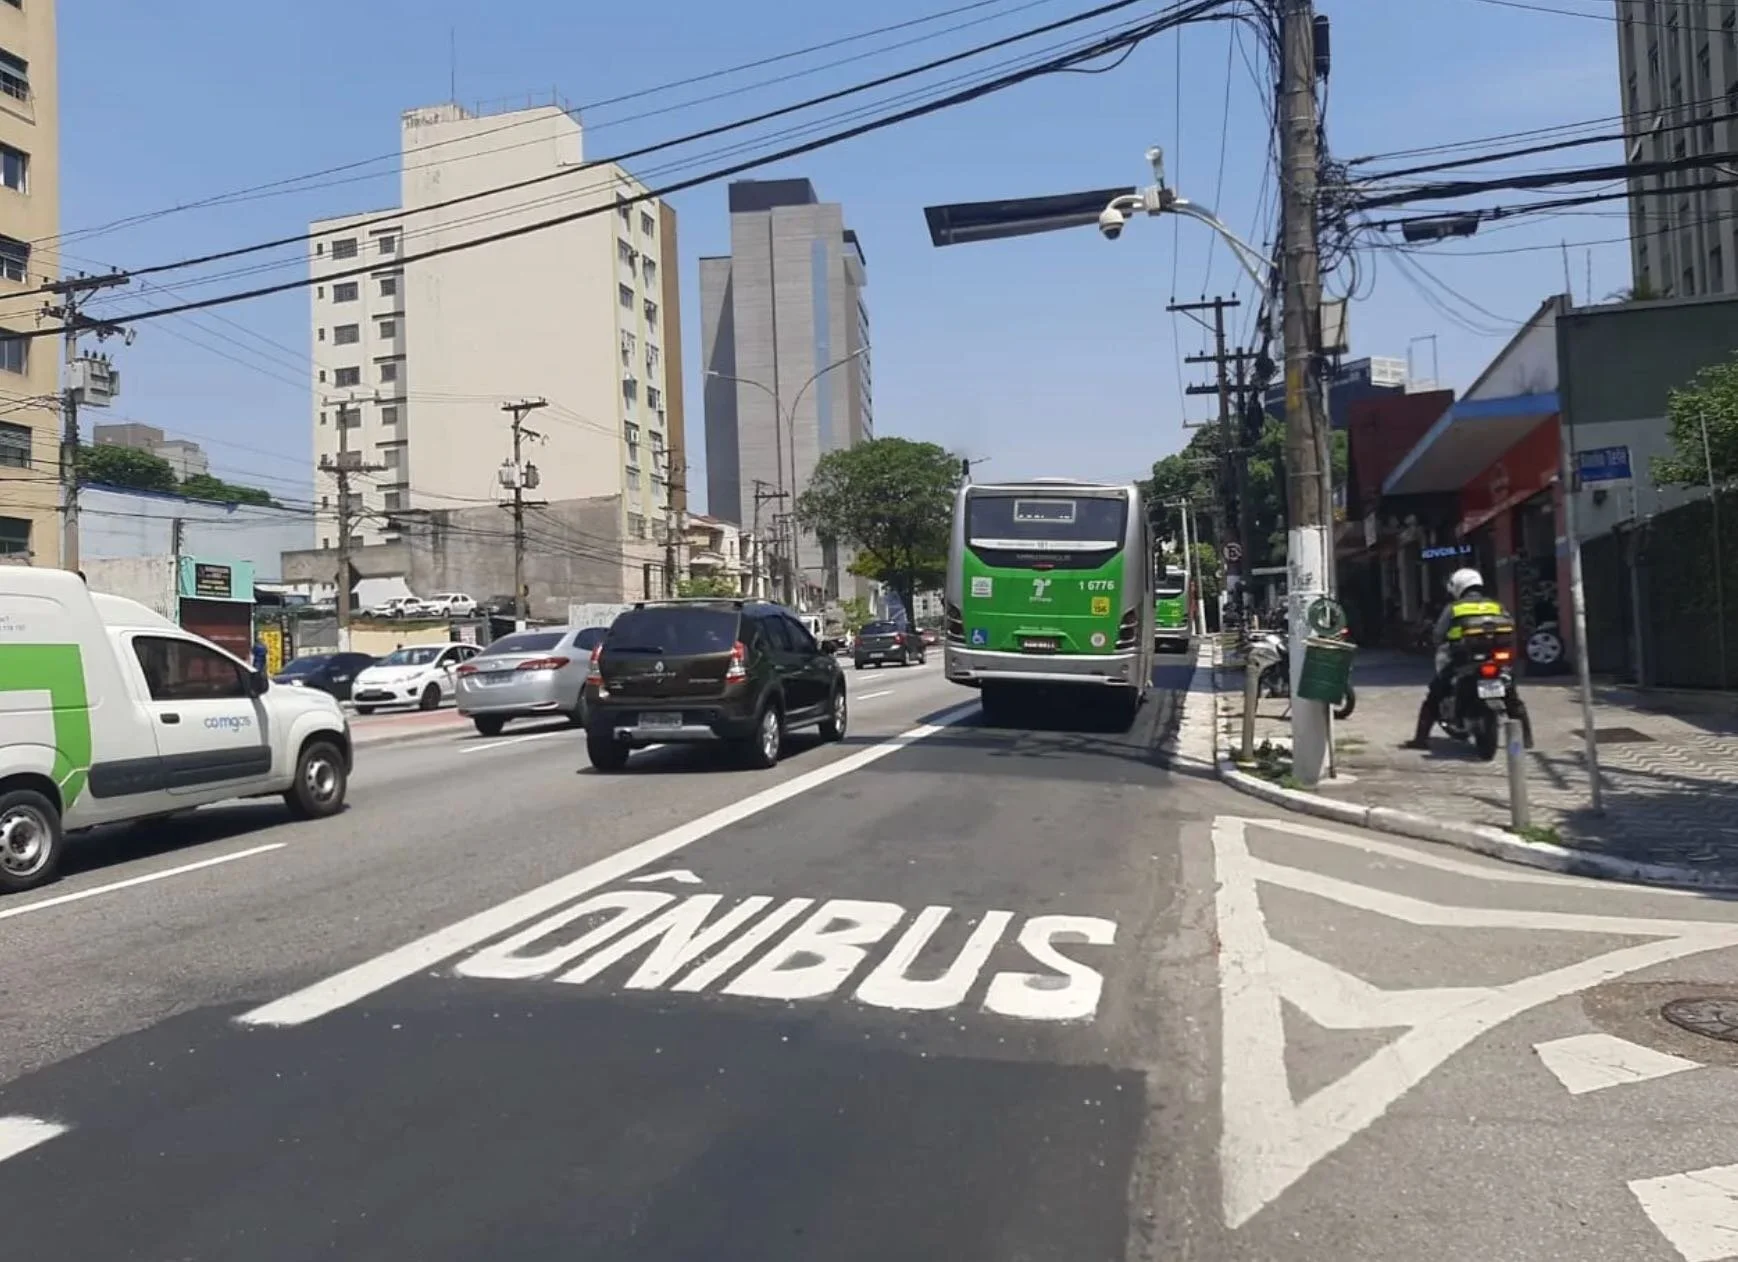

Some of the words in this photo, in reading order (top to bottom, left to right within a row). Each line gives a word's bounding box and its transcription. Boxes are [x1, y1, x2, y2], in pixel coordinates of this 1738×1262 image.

[1079, 580, 1085, 591] 1
[1087, 580, 1115, 591] 6776
[455, 869, 1117, 1021] ÔNIBUS
